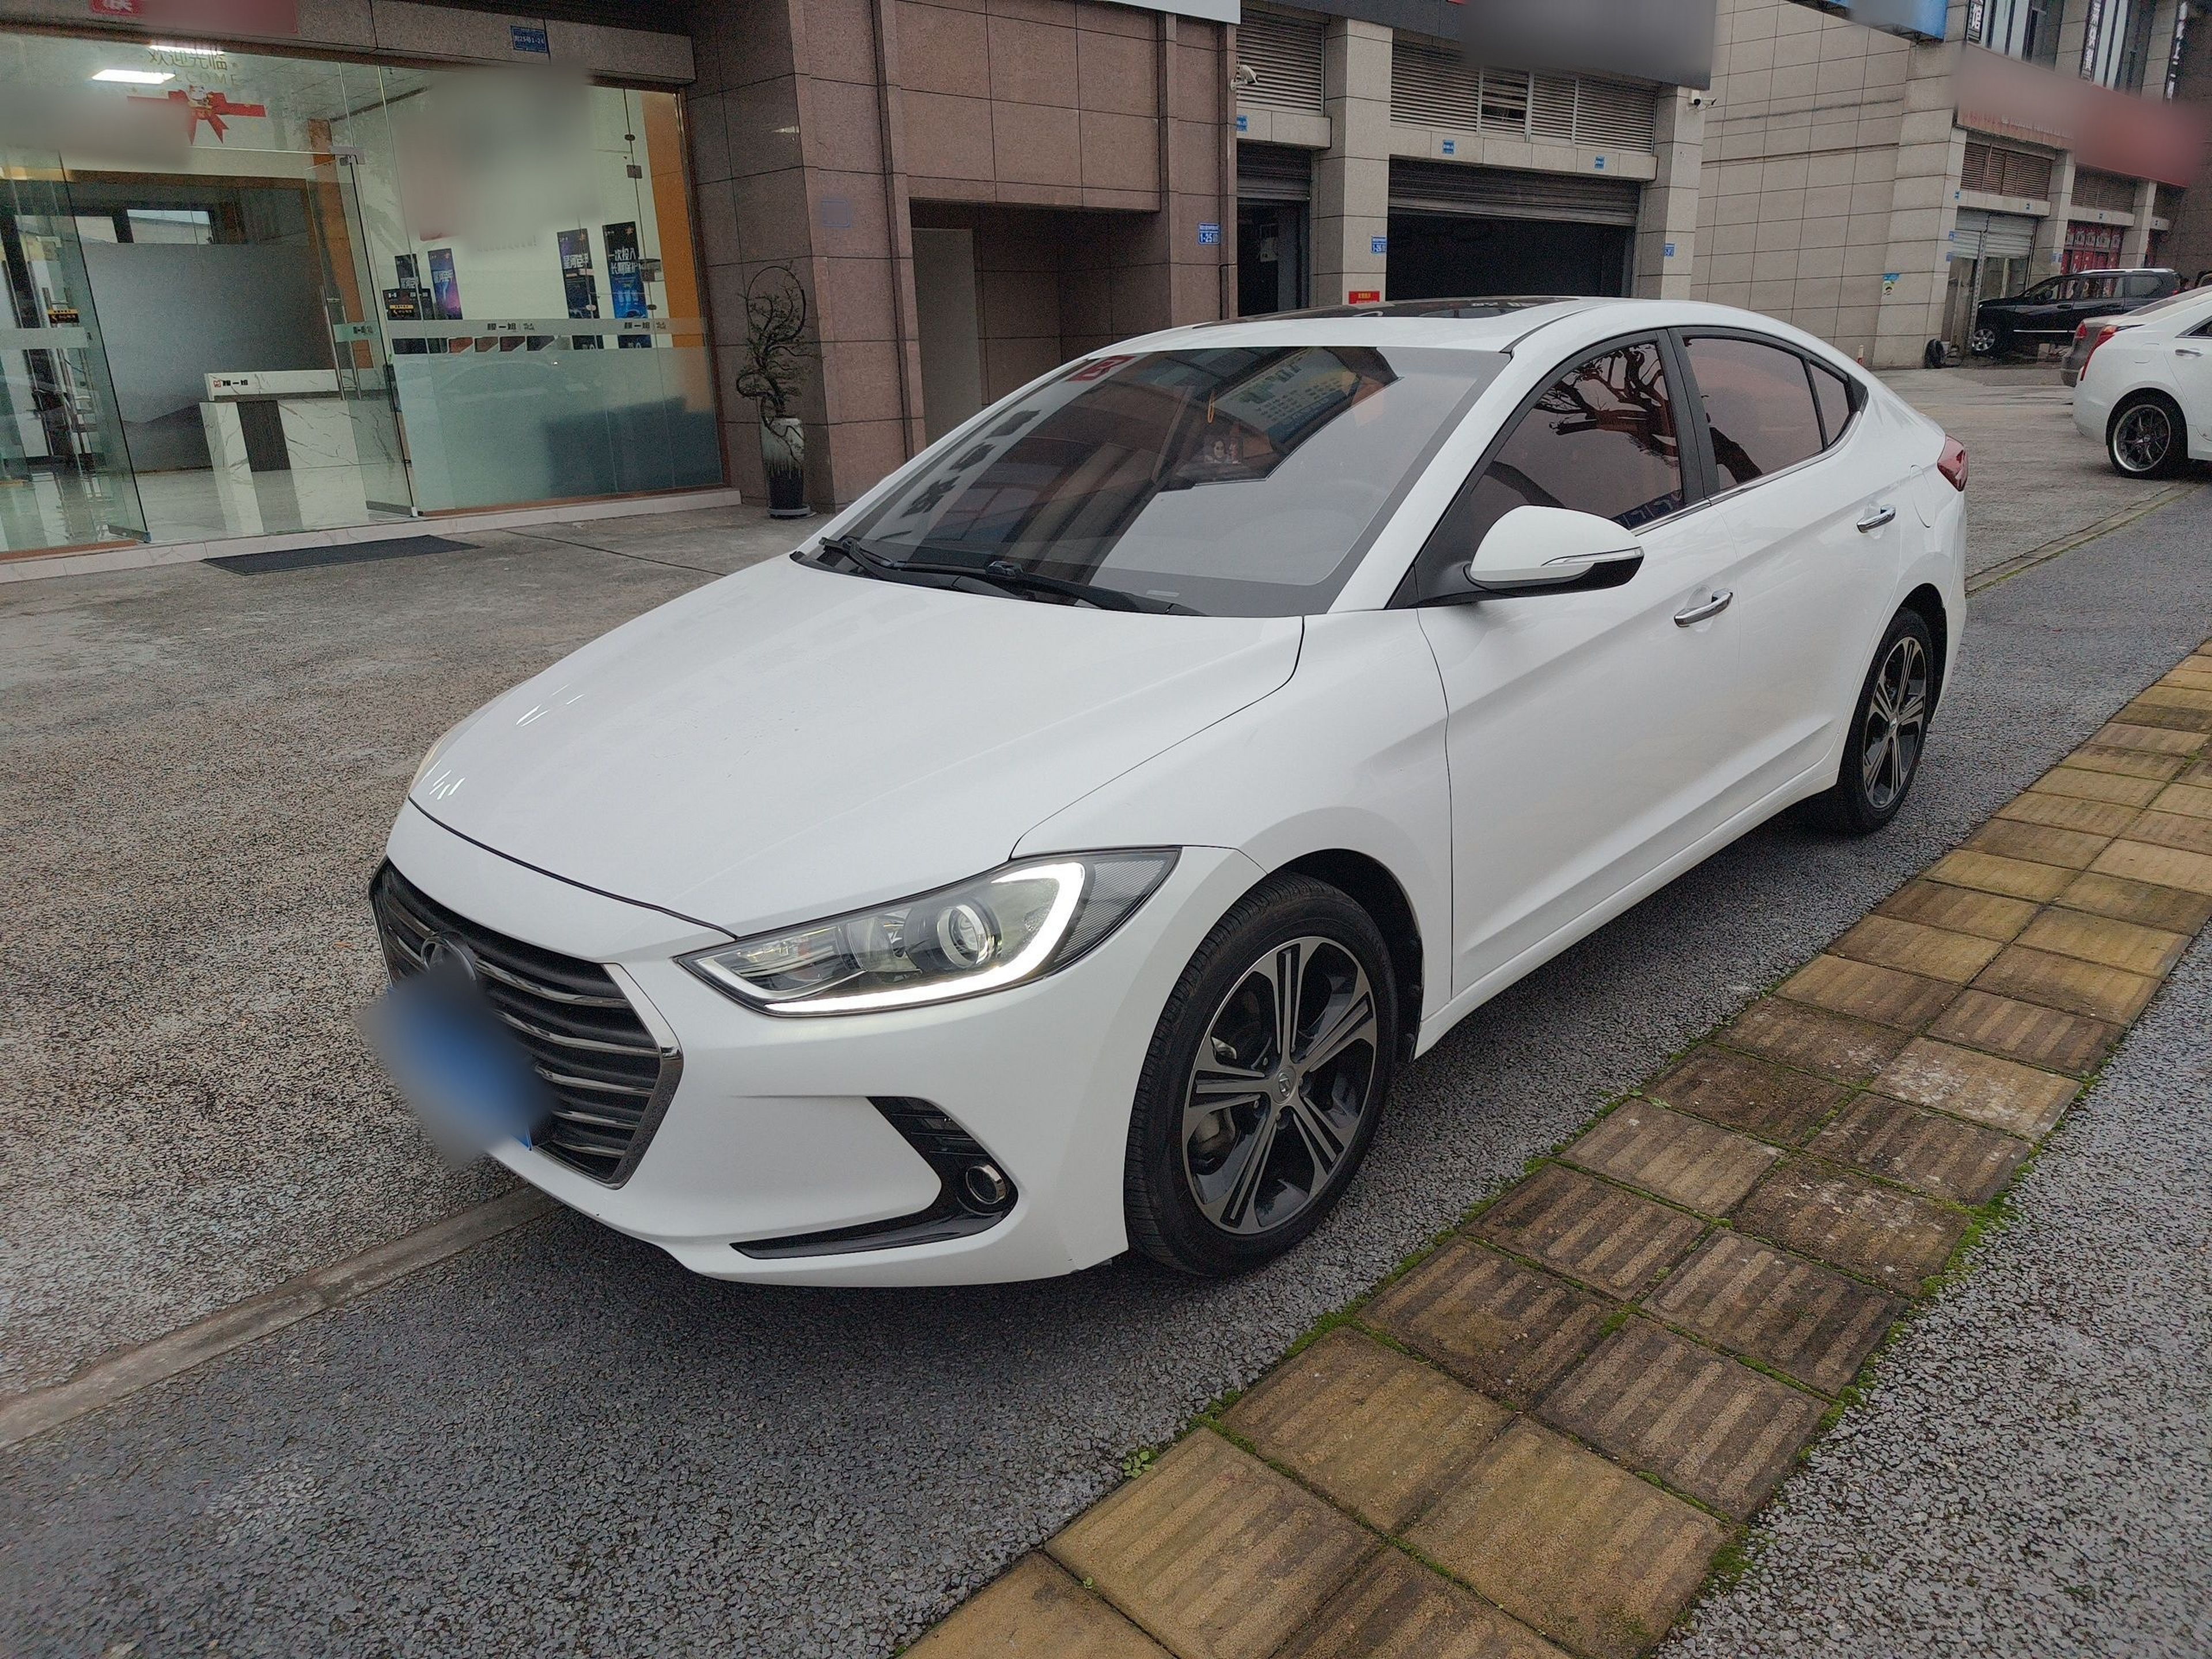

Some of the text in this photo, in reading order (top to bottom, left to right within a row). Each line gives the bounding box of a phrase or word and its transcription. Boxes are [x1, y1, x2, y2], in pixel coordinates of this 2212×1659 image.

[1971, 0, 1983, 30] 馆
[148, 43, 228, 70] 欢迎光临
